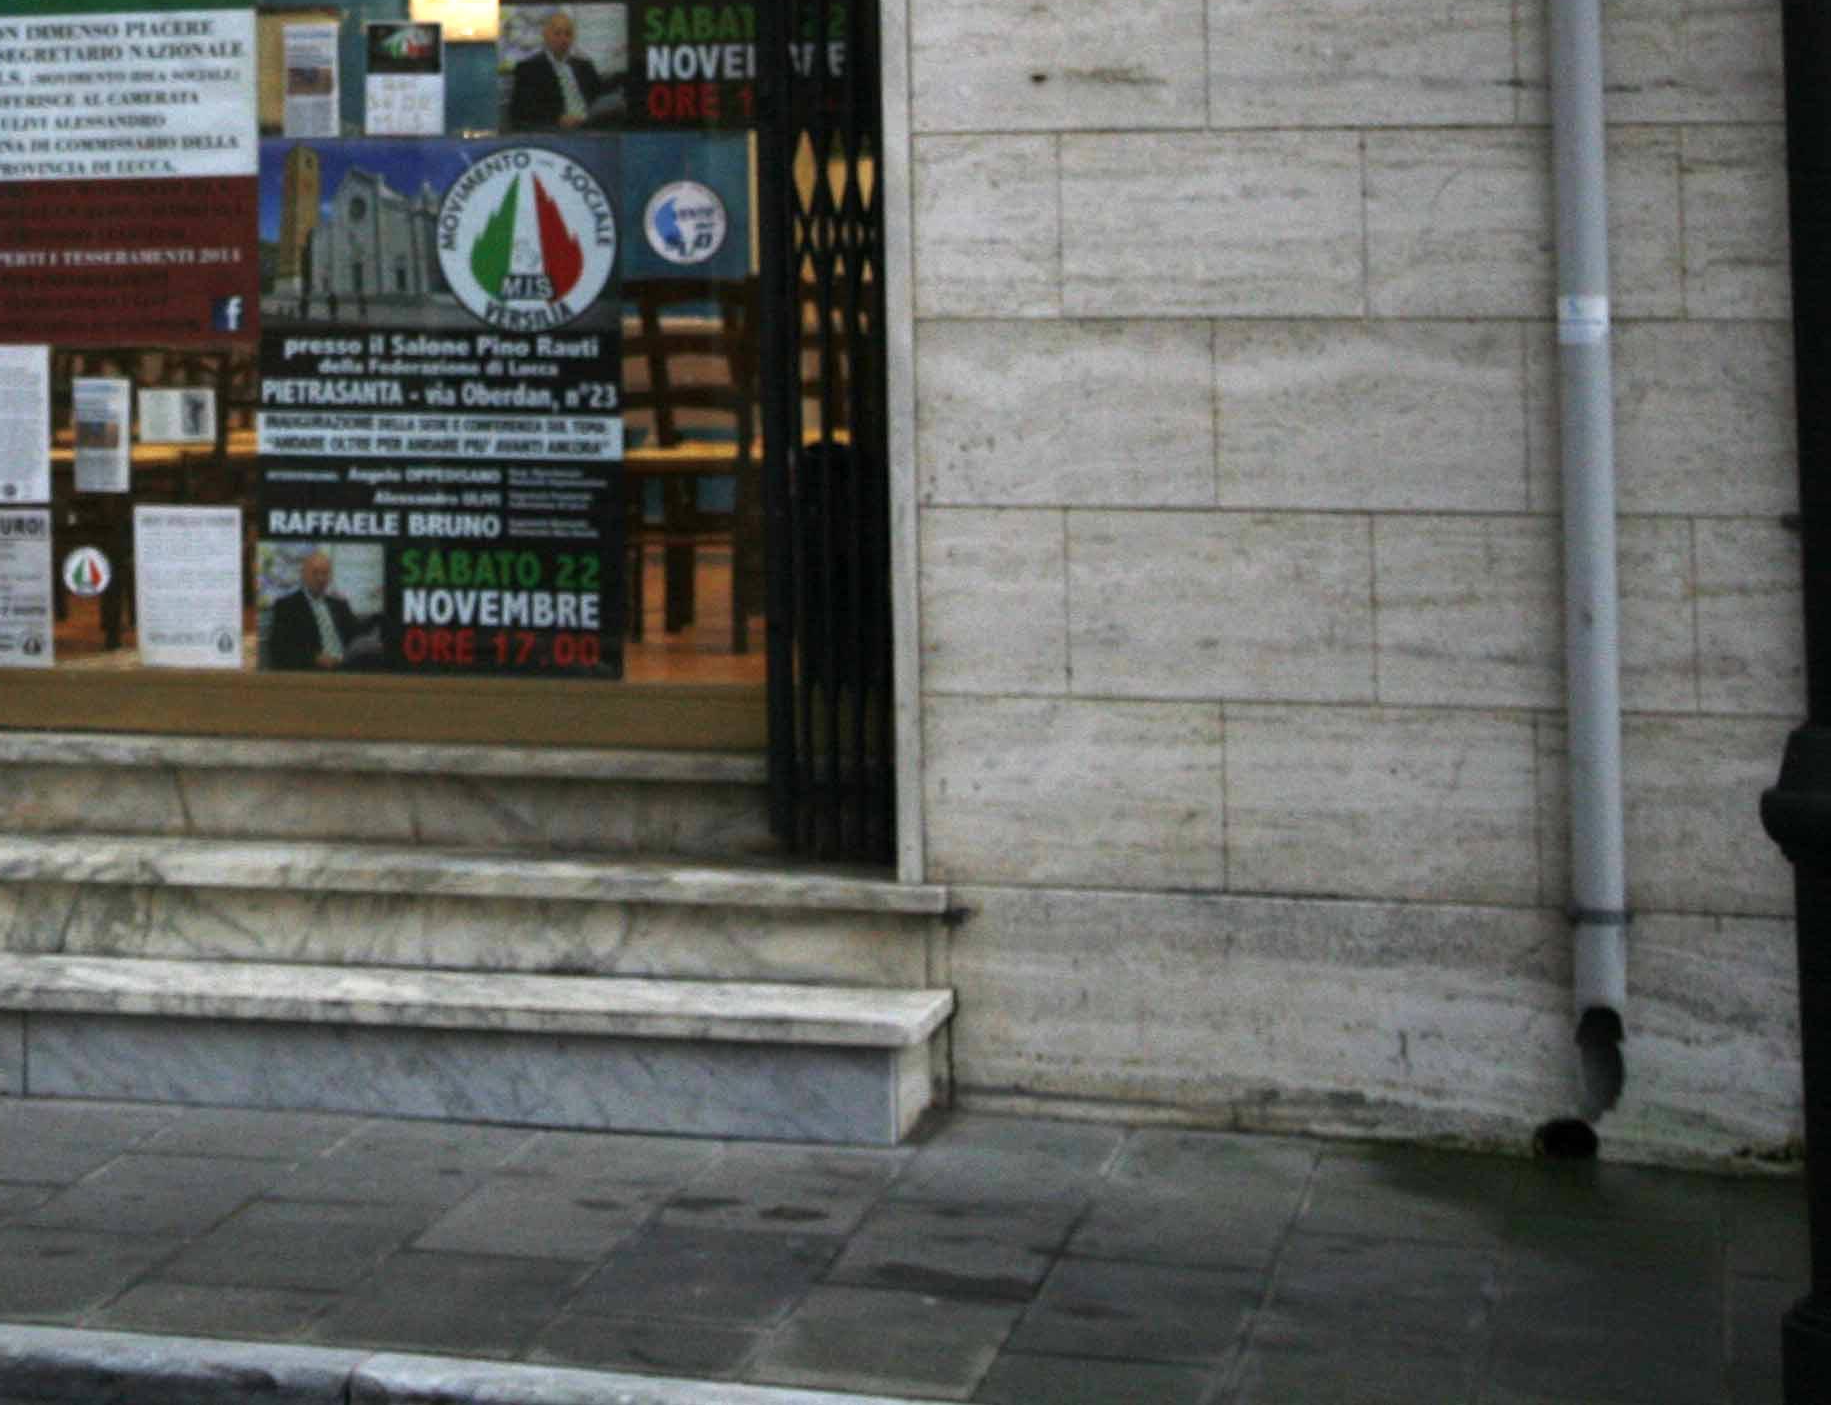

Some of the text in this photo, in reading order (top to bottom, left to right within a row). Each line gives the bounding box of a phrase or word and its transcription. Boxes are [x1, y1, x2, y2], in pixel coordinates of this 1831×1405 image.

[25, 22, 119, 41] IMMENSO
[124, 19, 214, 38] PIACERE
[644, 4, 758, 41] SABAT
[129, 41, 245, 60] NAZIONALE
[648, 83, 719, 120] ORE
[439, 152, 531, 250] MOVIMENTO
[560, 164, 612, 244] SOCIALE
[284, 338, 363, 360] presso
[390, 334, 470, 356] Salone
[476, 335, 530, 357] Pino
[536, 335, 600, 358] Rauti
[261, 378, 404, 405] PIETRASANTA
[424, 380, 456, 406] via
[269, 509, 399, 536] RAFFAELE
[408, 511, 501, 538] BRUNO
[401, 549, 601, 588] SABATO 22
[402, 590, 601, 628] NOVEMBRE
[403, 628, 600, 667] ORE 17.00
